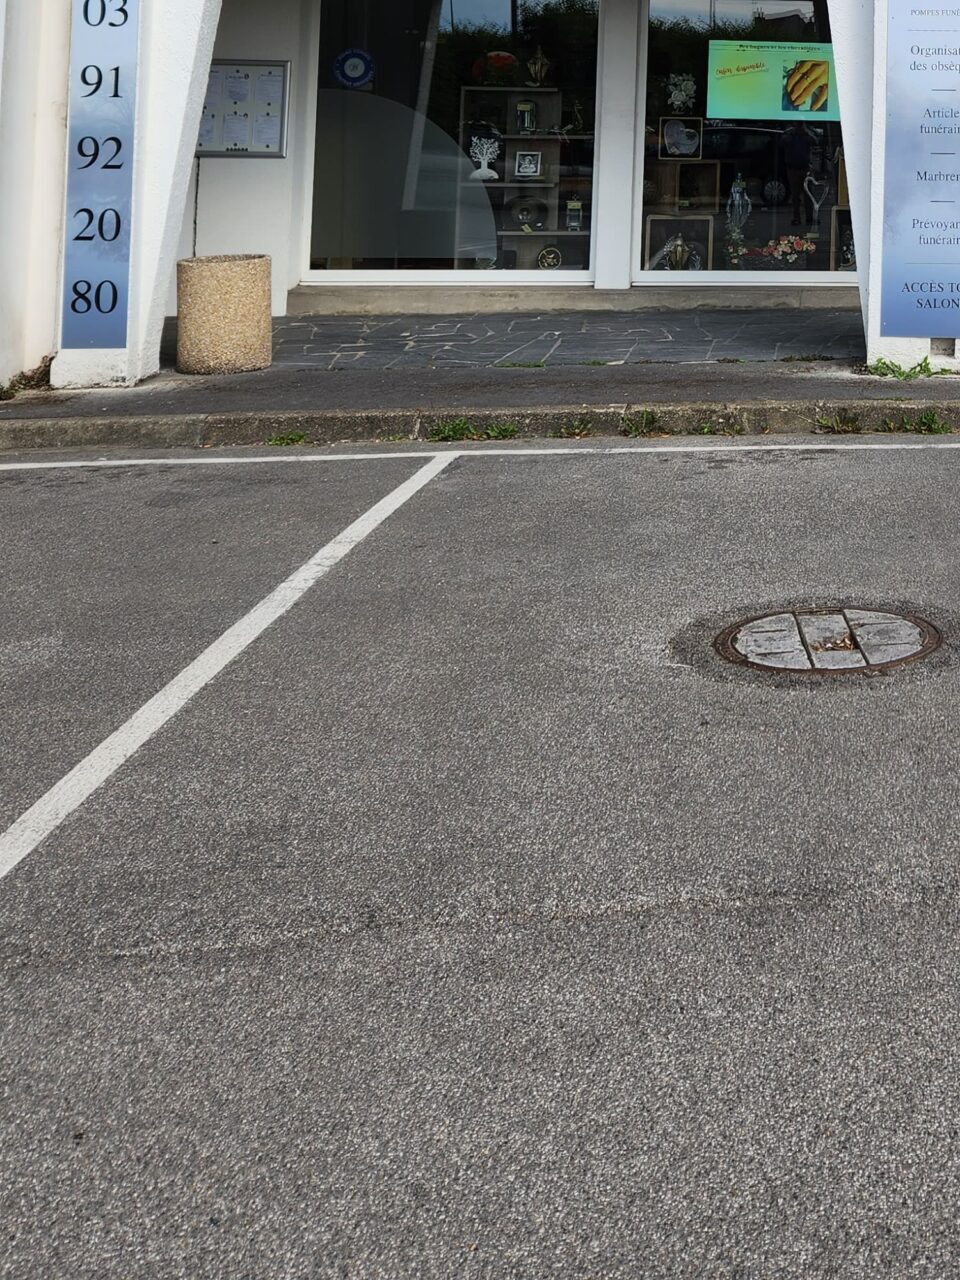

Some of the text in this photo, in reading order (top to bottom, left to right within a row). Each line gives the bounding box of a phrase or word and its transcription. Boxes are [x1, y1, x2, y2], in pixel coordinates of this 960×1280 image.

[80, 64, 124, 98] 91
[909, 60, 927, 71] des
[76, 136, 124, 170] 92
[72, 207, 121, 242] 20
[70, 280, 118, 314] 80
[901, 280, 944, 293] ACCÈS
